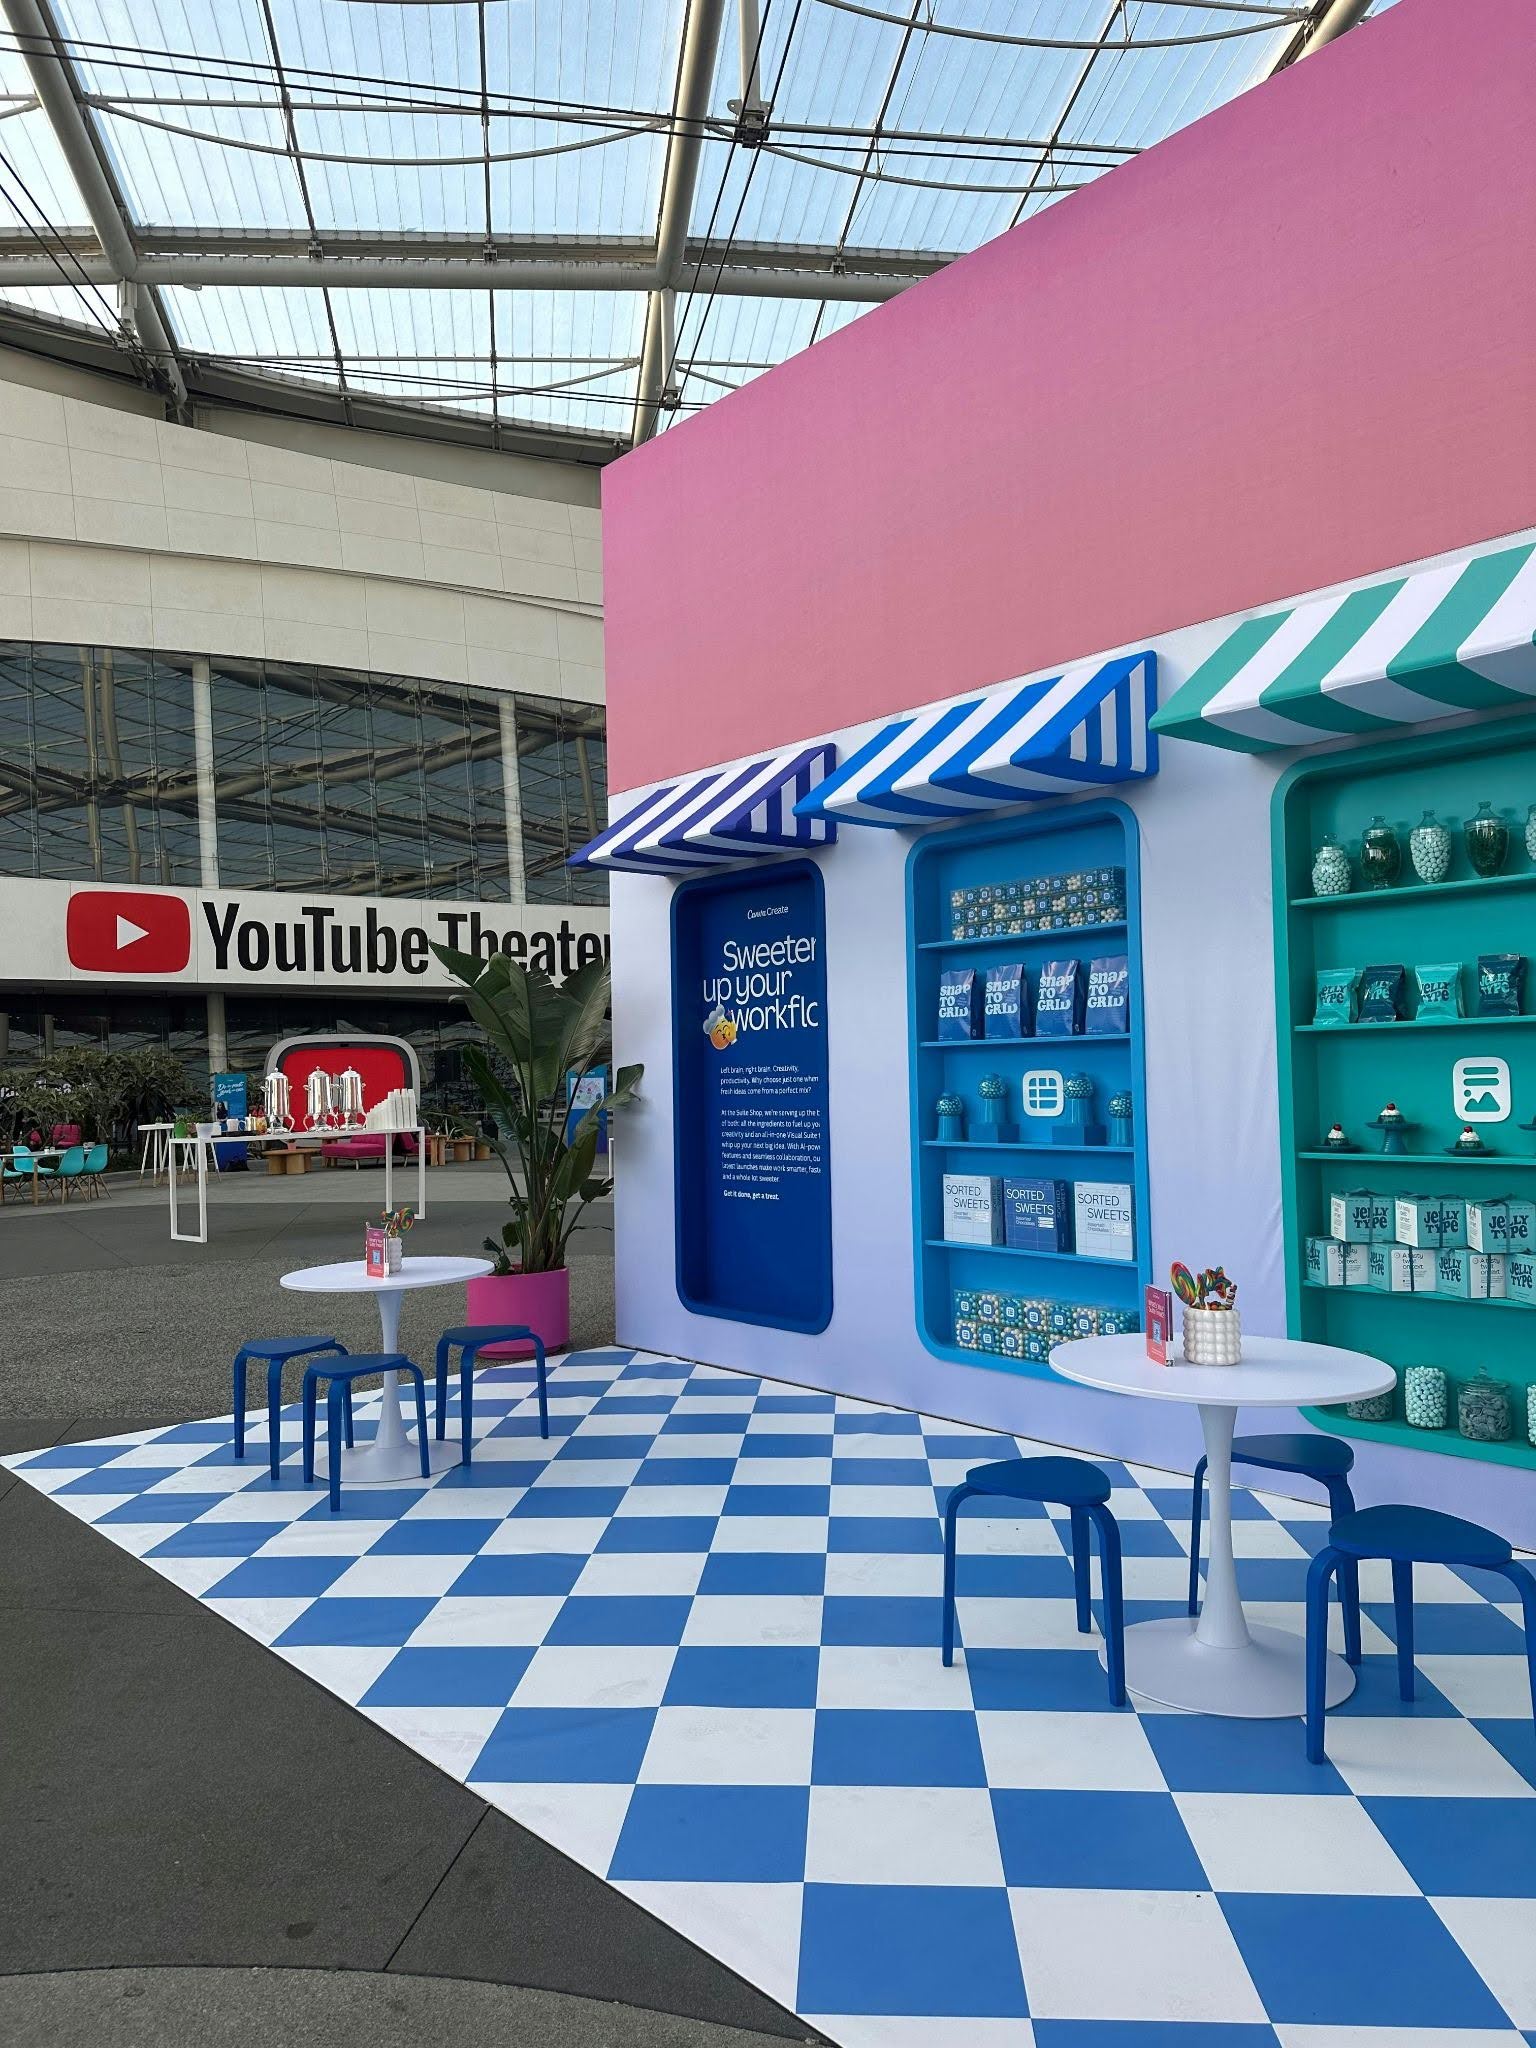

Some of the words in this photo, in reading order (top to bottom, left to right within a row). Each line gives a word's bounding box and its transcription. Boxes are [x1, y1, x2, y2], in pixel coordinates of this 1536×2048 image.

[748, 909, 766, 920] Canva
[766, 905, 789, 916] Create
[202, 901, 429, 975] YouTube
[703, 978, 732, 1005] up
[736, 970, 792, 1005] your
[1039, 987, 1056, 999] TO
[1089, 984, 1108, 996] TO
[940, 996, 955, 1007] TO
[986, 992, 1002, 1004] TO
[1088, 995, 1124, 1008] GRID
[985, 1003, 1018, 1015] GRID
[1038, 999, 1071, 1011] GRID
[730, 994, 819, 1031] workflo
[939, 1006, 968, 1018] GRID
[746, 1066, 757, 1074] right
[782, 1076, 792, 1084] just
[720, 1087, 733, 1095] fresh
[778, 1087, 798, 1095] perfect
[799, 1086, 811, 1094] mix?
[749, 1109, 764, 1117] Shop,
[778, 1110, 798, 1118] serving
[757, 1120, 785, 1128] ingredients
[722, 1131, 744, 1139] creativity
[764, 1142, 773, 1150] big
[786, 1142, 800, 1150] With
[722, 1151, 741, 1159] features
[752, 1152, 775, 1160] seamless
[776, 1153, 812, 1162] collaboration,
[786, 1166, 808, 1174] smarter,
[738, 1191, 751, 1199] done,
[752, 1192, 761, 1200] get
[946, 1185, 981, 1196] SORTED
[1007, 1188, 1044, 1201] SORTED
[954, 1198, 990, 1210] SWEETS
[1078, 1193, 1120, 1206] SORTED
[1016, 1203, 1054, 1215] SWEETS
[1087, 1208, 1130, 1221] SWEETS
